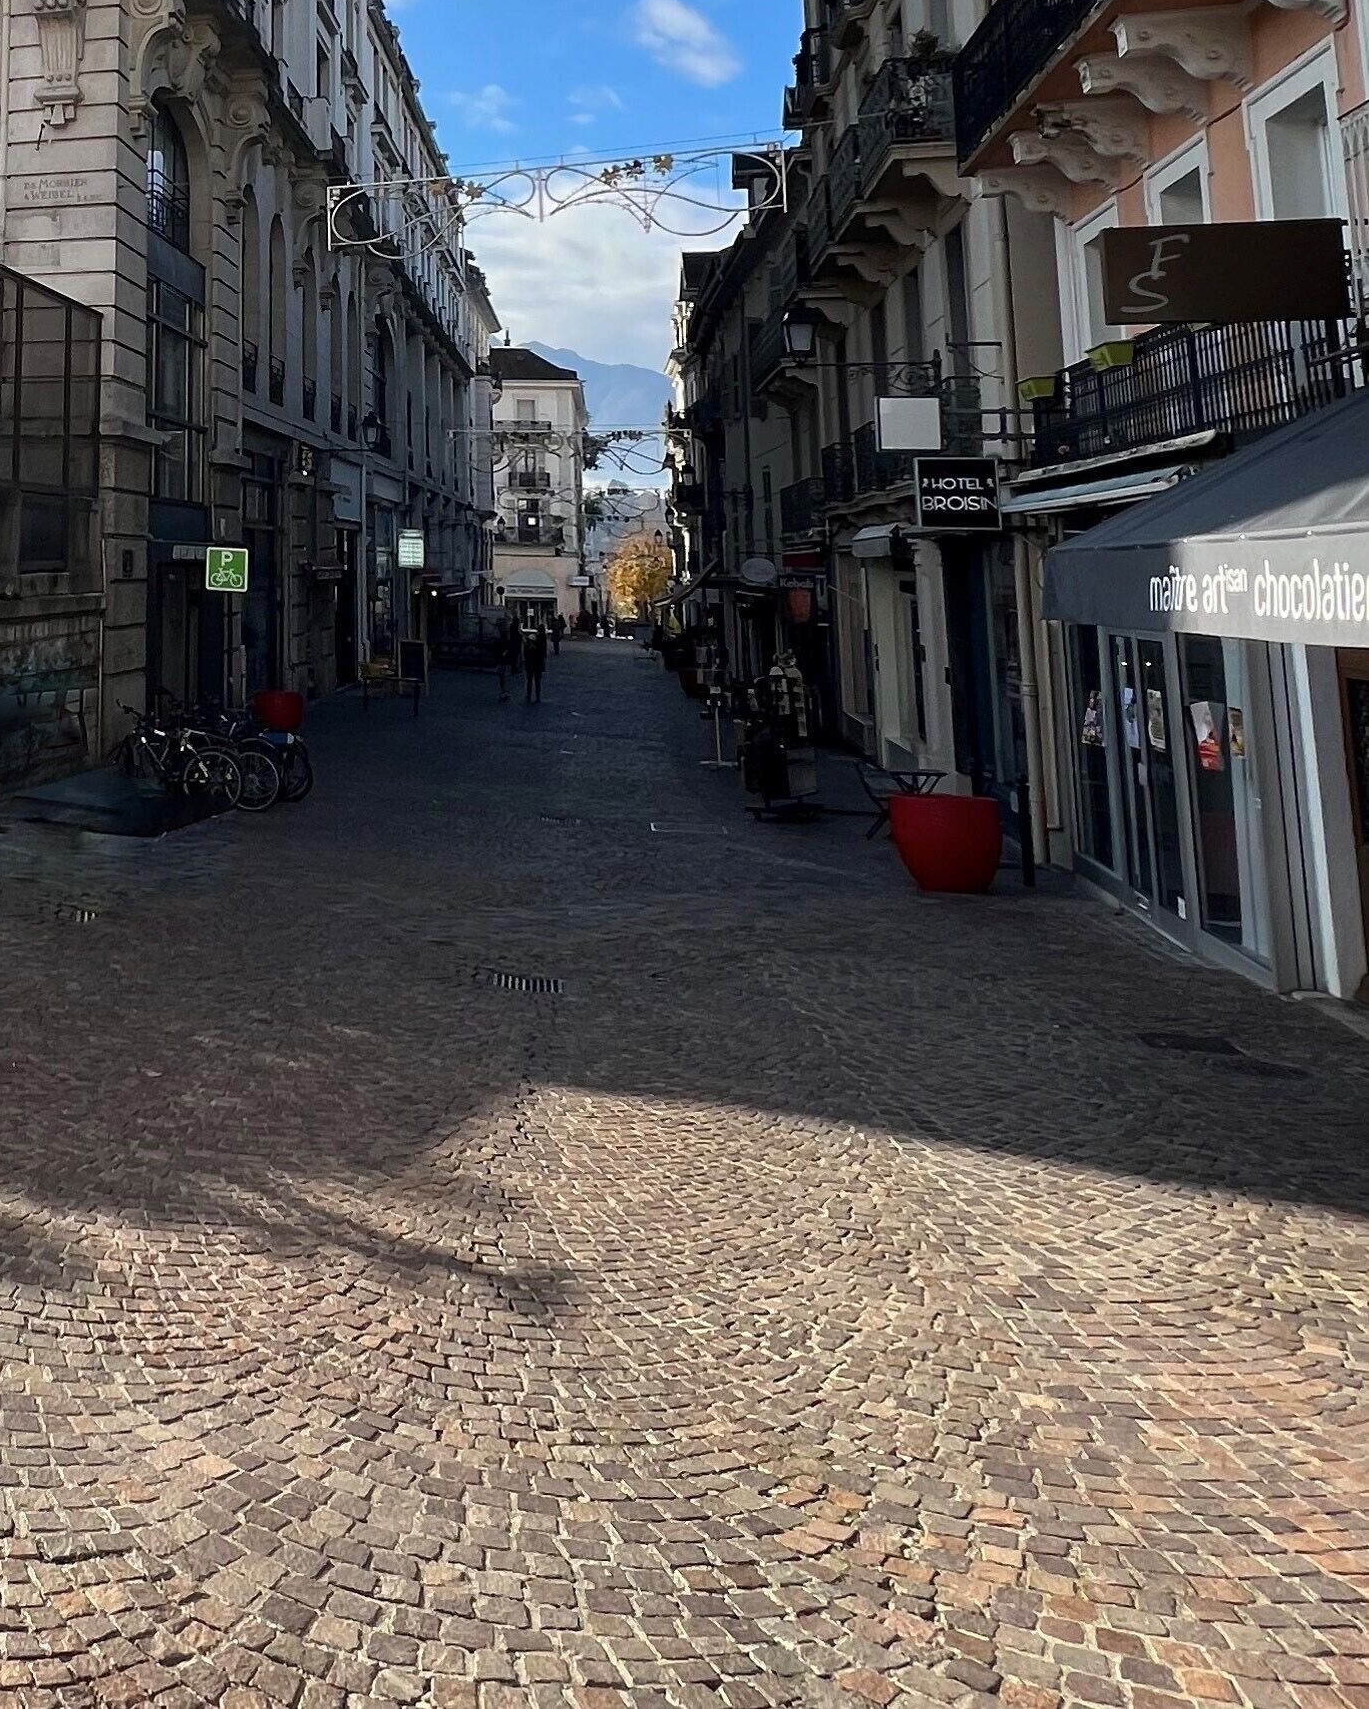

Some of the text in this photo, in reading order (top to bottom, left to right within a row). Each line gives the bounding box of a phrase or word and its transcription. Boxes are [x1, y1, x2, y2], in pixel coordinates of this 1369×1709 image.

[931, 477, 984, 490] HOTEL
[922, 495, 998, 510] BROISIN
[221, 551, 234, 567] P
[1149, 564, 1198, 613] maître
[1254, 558, 1369, 622] chocolatie
